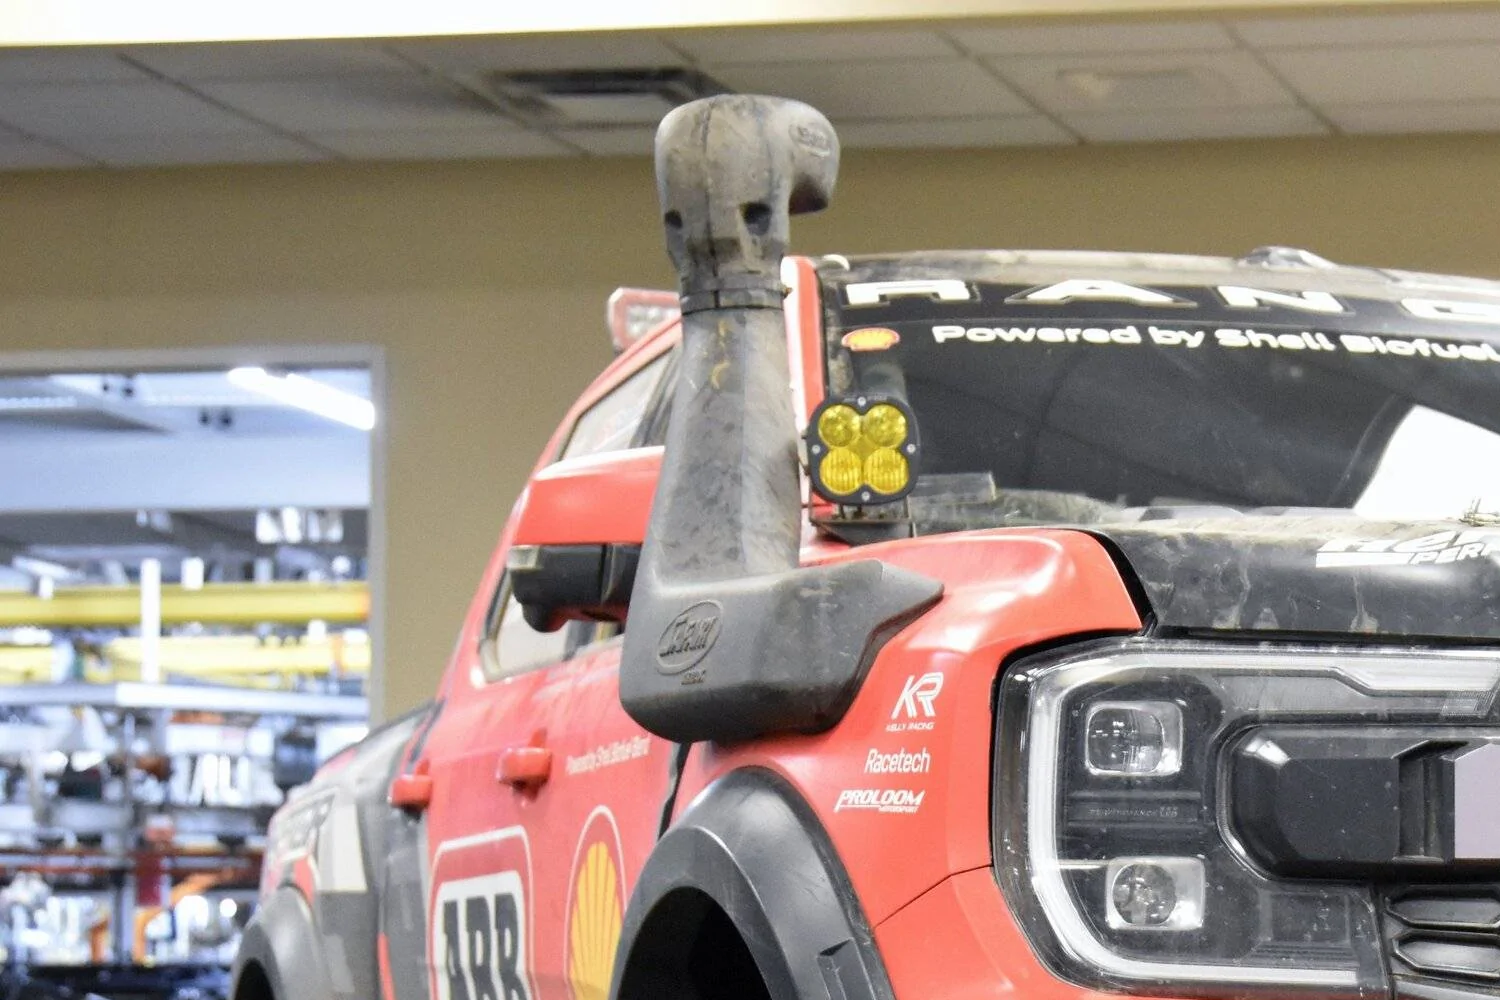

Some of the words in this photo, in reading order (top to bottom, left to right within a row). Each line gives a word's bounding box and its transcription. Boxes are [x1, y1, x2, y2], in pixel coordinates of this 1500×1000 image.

[931, 325, 1142, 345] Powered
[1148, 325, 1204, 349] by
[1213, 328, 1337, 352] Shell
[864, 747, 931, 774] Racetech
[834, 788, 926, 812] PROLOOM
